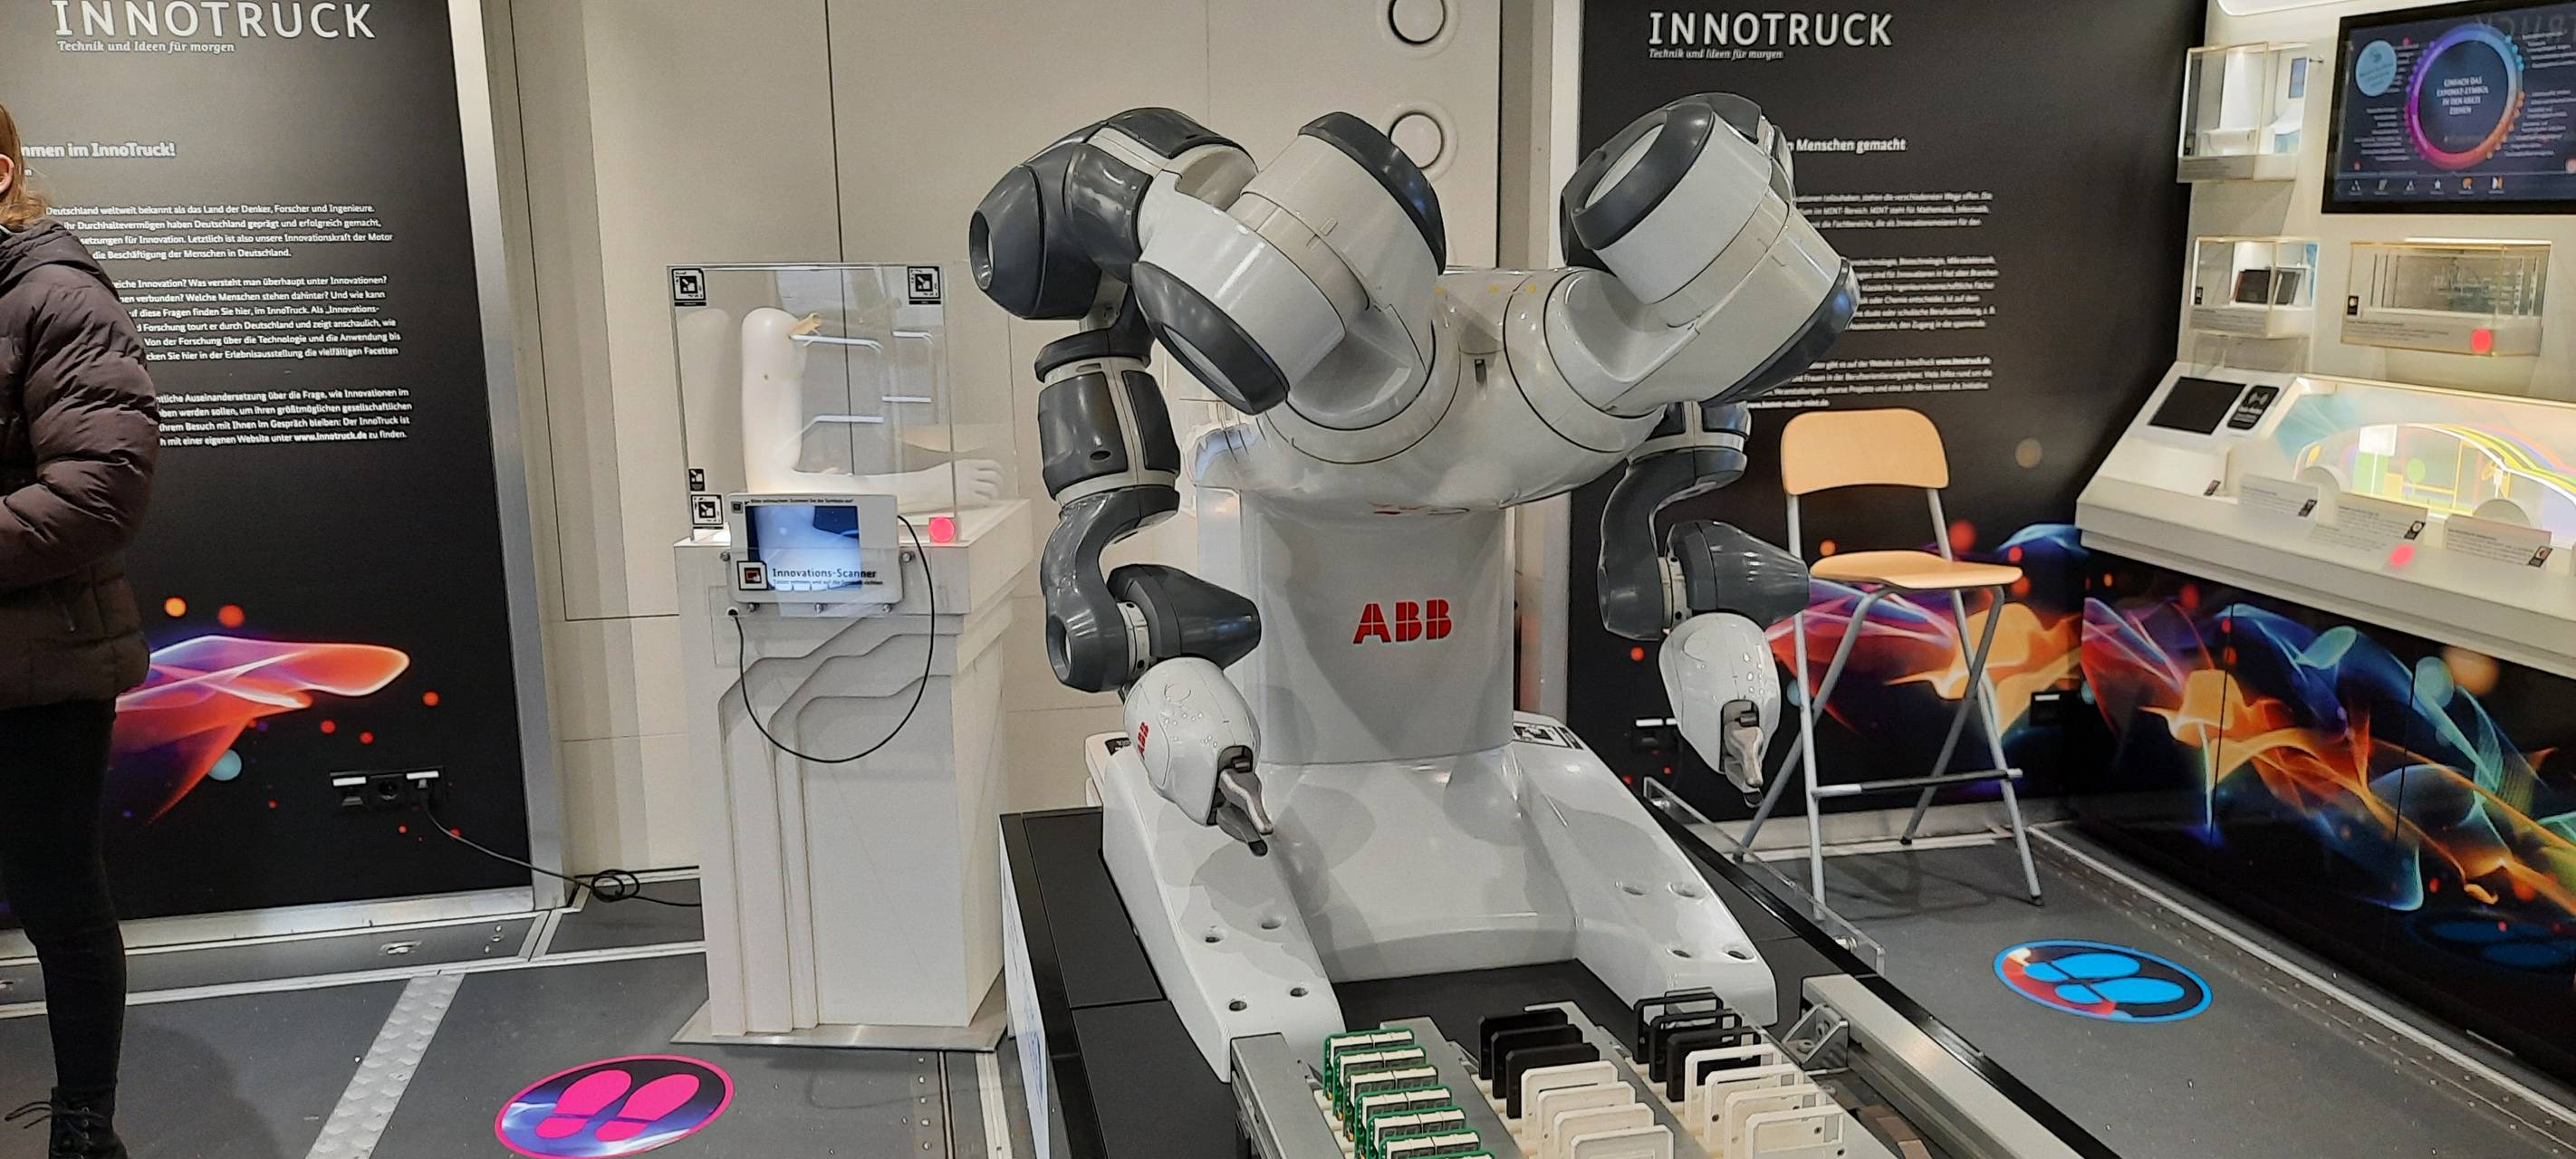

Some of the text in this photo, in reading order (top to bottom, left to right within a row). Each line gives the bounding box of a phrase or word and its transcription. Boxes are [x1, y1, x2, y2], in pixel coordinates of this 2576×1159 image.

[51, 0, 376, 38] INNOTRUCK
[1648, 12, 1893, 45] INNOTRUCK
[57, 40, 235, 55] Technik und Ideen für morgen
[1648, 48, 1684, 59] Technik
[1686, 49, 1705, 59] und
[1731, 48, 1746, 62] für
[67, 142, 89, 158] im
[91, 141, 177, 158] InnoTruck!
[1796, 138, 1856, 152] Menschen
[1855, 138, 1907, 155] gemacht
[45, 204, 375, 216] Deutschland weltweit bekannt als das Land der Denker, Forscher und Ingenieure.
[63, 221, 76, 230] ihr
[166, 220, 193, 229] haben
[194, 219, 246, 228] Deutschland
[247, 219, 280, 230] geprägt
[280, 218, 297, 228] und
[298, 218, 343, 229] erfolgreich
[343, 218, 381, 229] gemacht,
[124, 235, 138, 244] für
[138, 235, 187, 244] Innovation.
[187, 235, 224, 244] Letztlich
[224, 234, 236, 243] ist
[236, 234, 255, 243] also
[352, 233, 367, 242] der
[368, 233, 393, 241] Motor
[91, 248, 292, 261] die Beschäftigung der Menschen in Deutschland.
[137, 278, 187, 288] Innovation?
[187, 279, 207, 287] Was
[207, 278, 243, 287] versteht
[263, 277, 305, 287] überhaupt
[306, 277, 329, 285] unter
[330, 275, 388, 285] Innovationen?
[135, 293, 185, 303] verbunden?
[185, 292, 217, 302] Welche
[217, 292, 261, 302] Menschen
[262, 292, 290, 301] stehen
[291, 291, 329, 301] dahinter?
[330, 291, 349, 300] Und
[349, 290, 364, 299] wie
[364, 290, 386, 299] kann
[139, 309, 161, 318] diese
[162, 308, 192, 319] Fragen
[192, 307, 220, 316] finden
[220, 307, 234, 316] Sie
[235, 306, 254, 316] hier,
[254, 306, 266, 315] im
[266, 305, 311, 315] InnoTruck.
[311, 305, 324, 314] Als
[324, 304, 380, 314] „Innovations-
[142, 322, 187, 333] Forschung
[187, 322, 208, 331] tourt
[218, 321, 243, 330] durch
[244, 320, 294, 330] Deutschland
[294, 320, 312, 329] und
[312, 320, 332, 330] zeigt
[332, 319, 381, 328] anschaulich,
[143, 331, 401, 347] Von der Forschung über die Technologie und die Anwendung bis
[167, 351, 180, 360] Sie
[181, 351, 198, 360] hier
[198, 350, 208, 359] in
[208, 350, 224, 359] der
[304, 348, 318, 357] die
[318, 347, 363, 358] vielfältigen
[363, 346, 399, 355] Facetten
[267, 391, 287, 400] über
[288, 390, 302, 400] die
[302, 390, 328, 401] Frage,
[328, 389, 343, 398] wie
[343, 388, 398, 398] Innovationen
[398, 388, 409, 397] im
[178, 407, 210, 417] werden
[210, 407, 239, 417] sollen,
[238, 407, 254, 416] um
[254, 405, 276, 415] ihren
[185, 421, 216, 431] Besuch
[216, 420, 231, 430] mit
[231, 420, 257, 430] Ihnen
[257, 419, 270, 428] im
[270, 418, 309, 429] Gespräch
[309, 417, 341, 427] bleiben:
[342, 417, 358, 426] Der
[359, 416, 399, 426] InnoTruck
[399, 416, 410, 425] ist
[167, 436, 182, 446] mit
[182, 436, 204, 445] einer
[204, 436, 236, 446] eigenen
[236, 434, 270, 444] Website
[270, 434, 293, 443] unter
[379, 429, 408, 438] finden.
[772, 568, 878, 579] Innovations-Scanner
[1352, 599, 1453, 645] ABB
